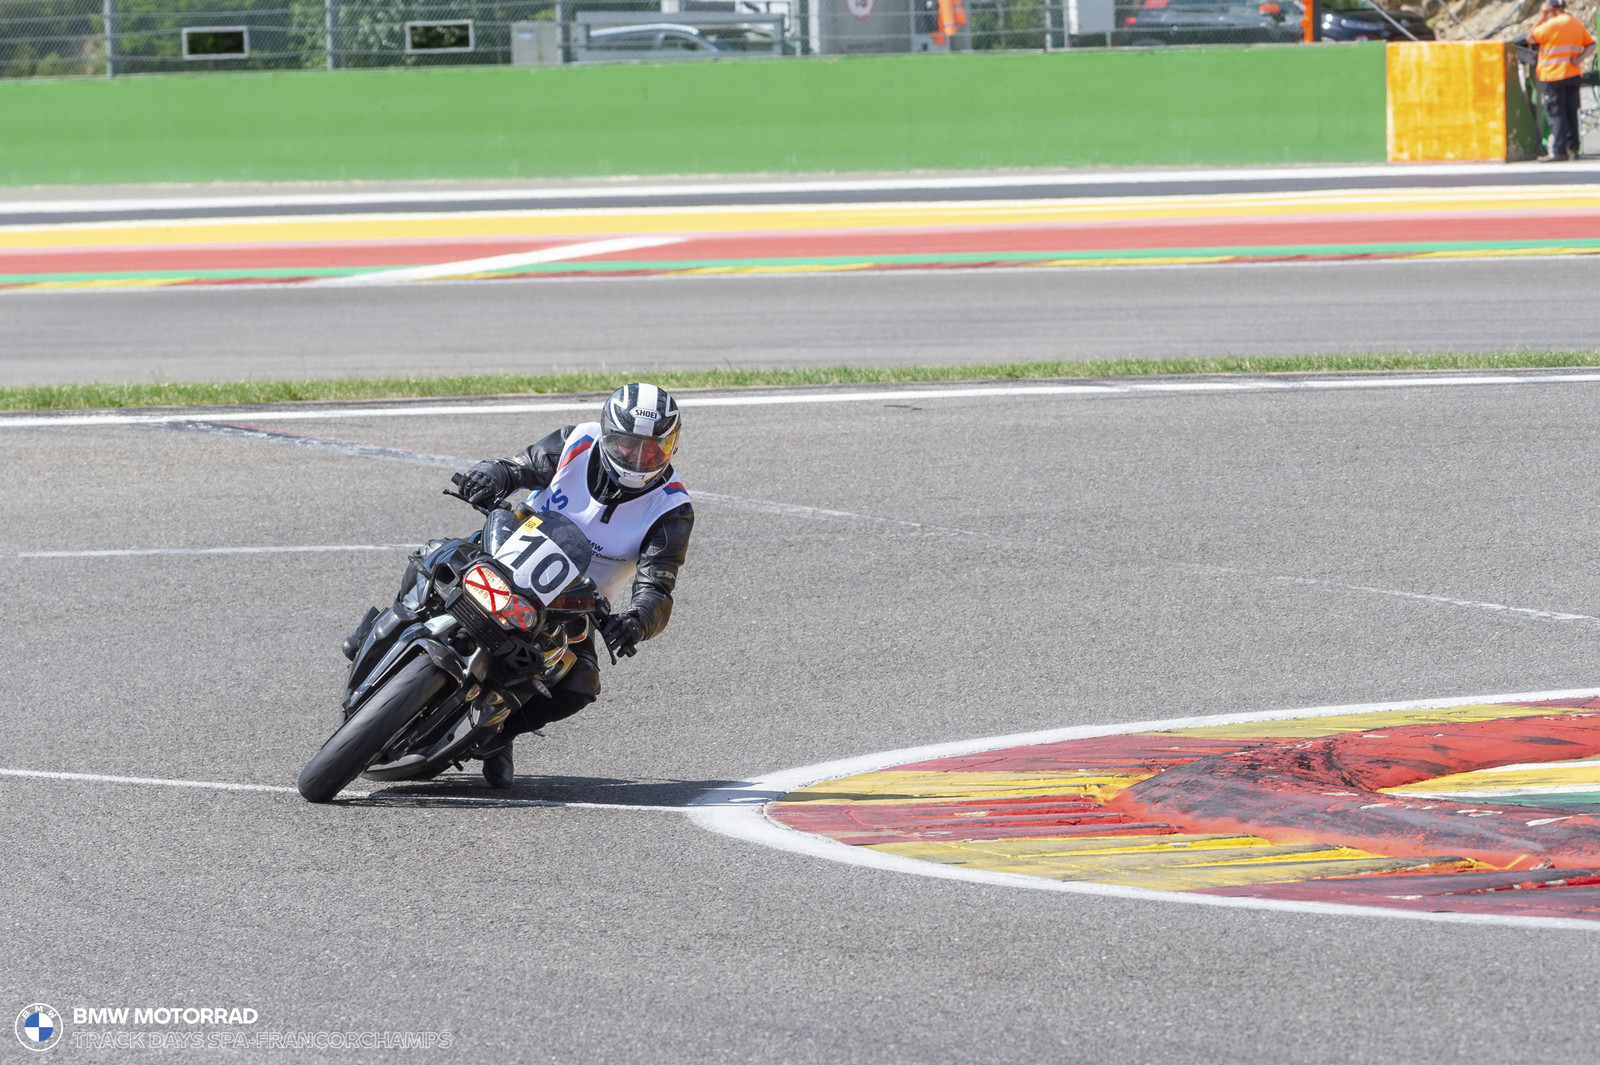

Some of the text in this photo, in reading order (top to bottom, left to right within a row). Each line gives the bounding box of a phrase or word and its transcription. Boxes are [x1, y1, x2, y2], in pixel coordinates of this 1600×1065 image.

[635, 409, 657, 419] SHOEI
[537, 488, 569, 514] YS
[510, 535, 570, 594] 10
[591, 550, 626, 562] TORRAD
